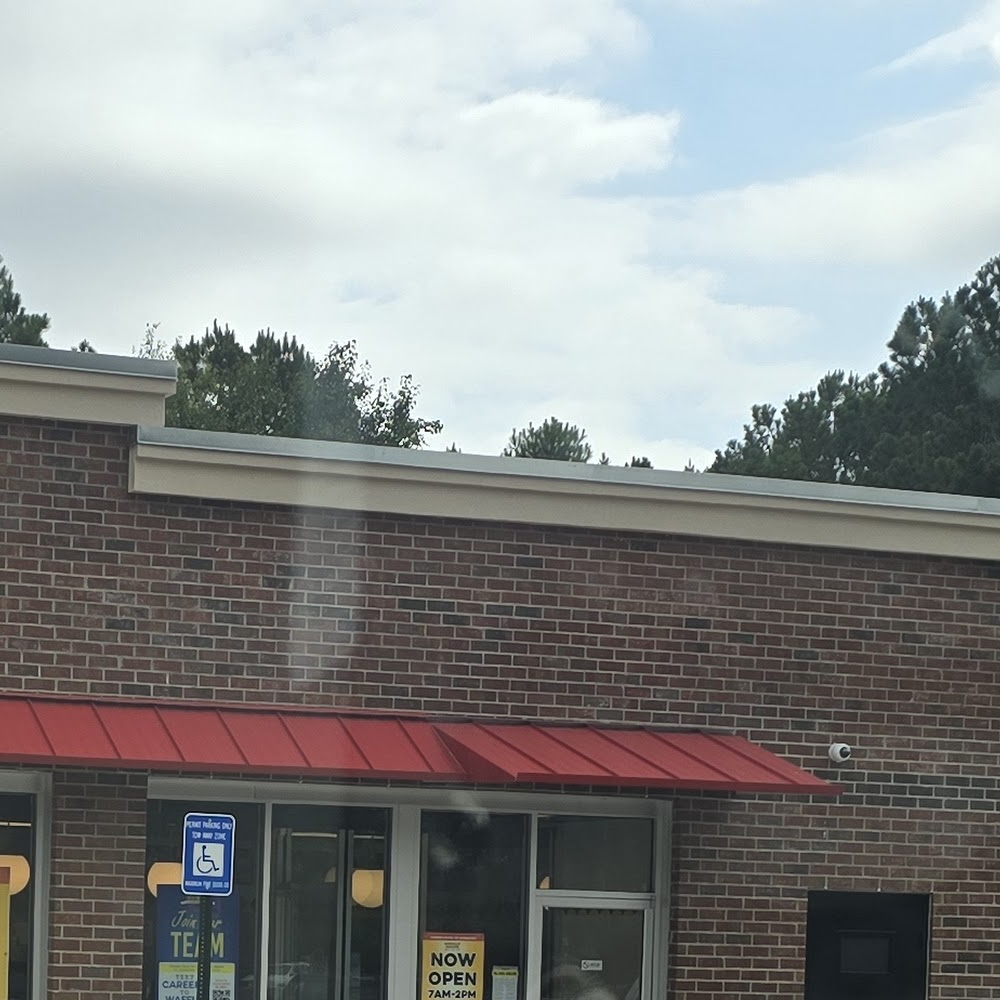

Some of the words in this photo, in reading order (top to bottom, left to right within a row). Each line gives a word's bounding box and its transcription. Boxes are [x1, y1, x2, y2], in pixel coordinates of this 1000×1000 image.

[171, 910, 197, 928] Join
[431, 952, 476, 967] NOW
[428, 971, 477, 986] OPEN
[428, 990, 476, 998] 7AM-2PM
